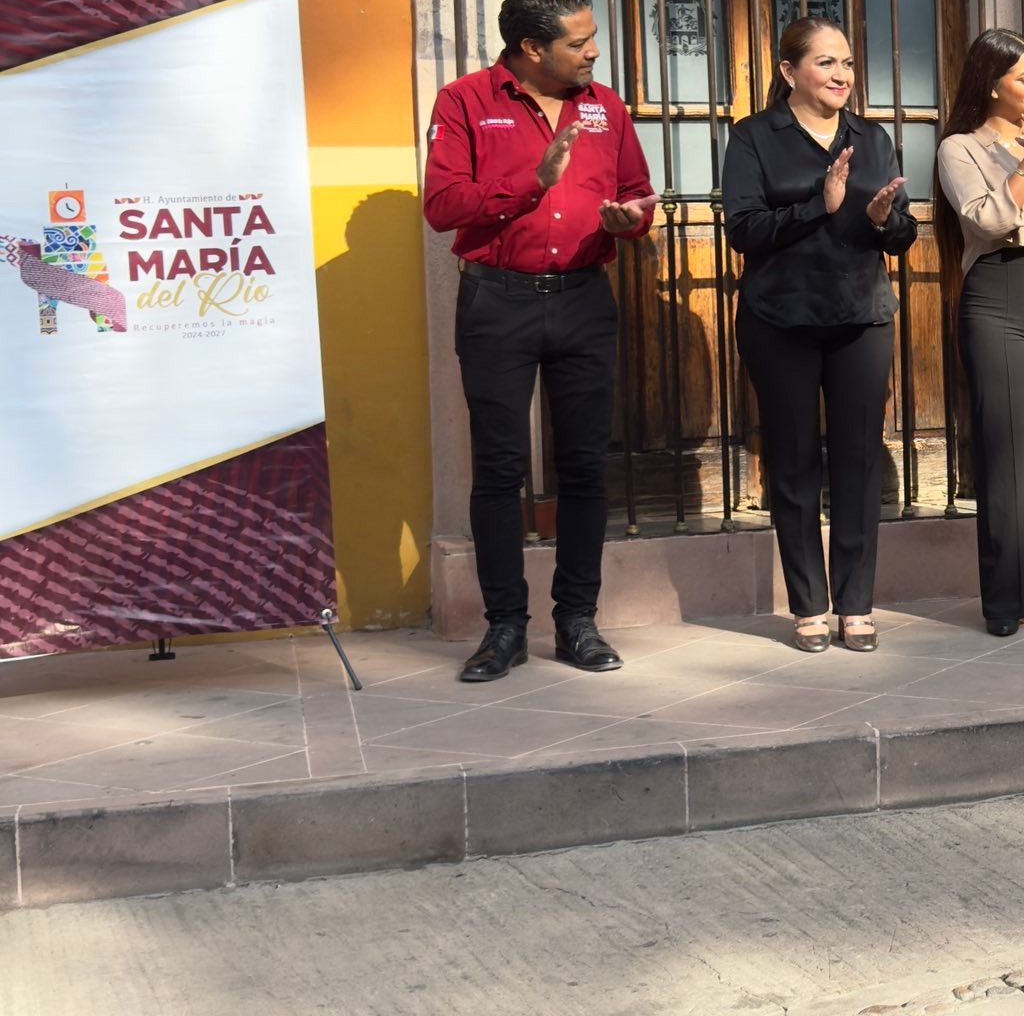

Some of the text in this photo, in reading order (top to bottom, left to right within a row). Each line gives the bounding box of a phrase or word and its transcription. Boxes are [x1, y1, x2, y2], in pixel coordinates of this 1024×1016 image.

[143, 193, 237, 206] H. Ayuntamiento de
[119, 204, 276, 241] SANTA
[128, 237, 276, 282] MARÍA
[136, 278, 187, 310] del
[133, 317, 276, 333] Recuperemos la magia
[182, 329, 226, 340] 2024-2027
